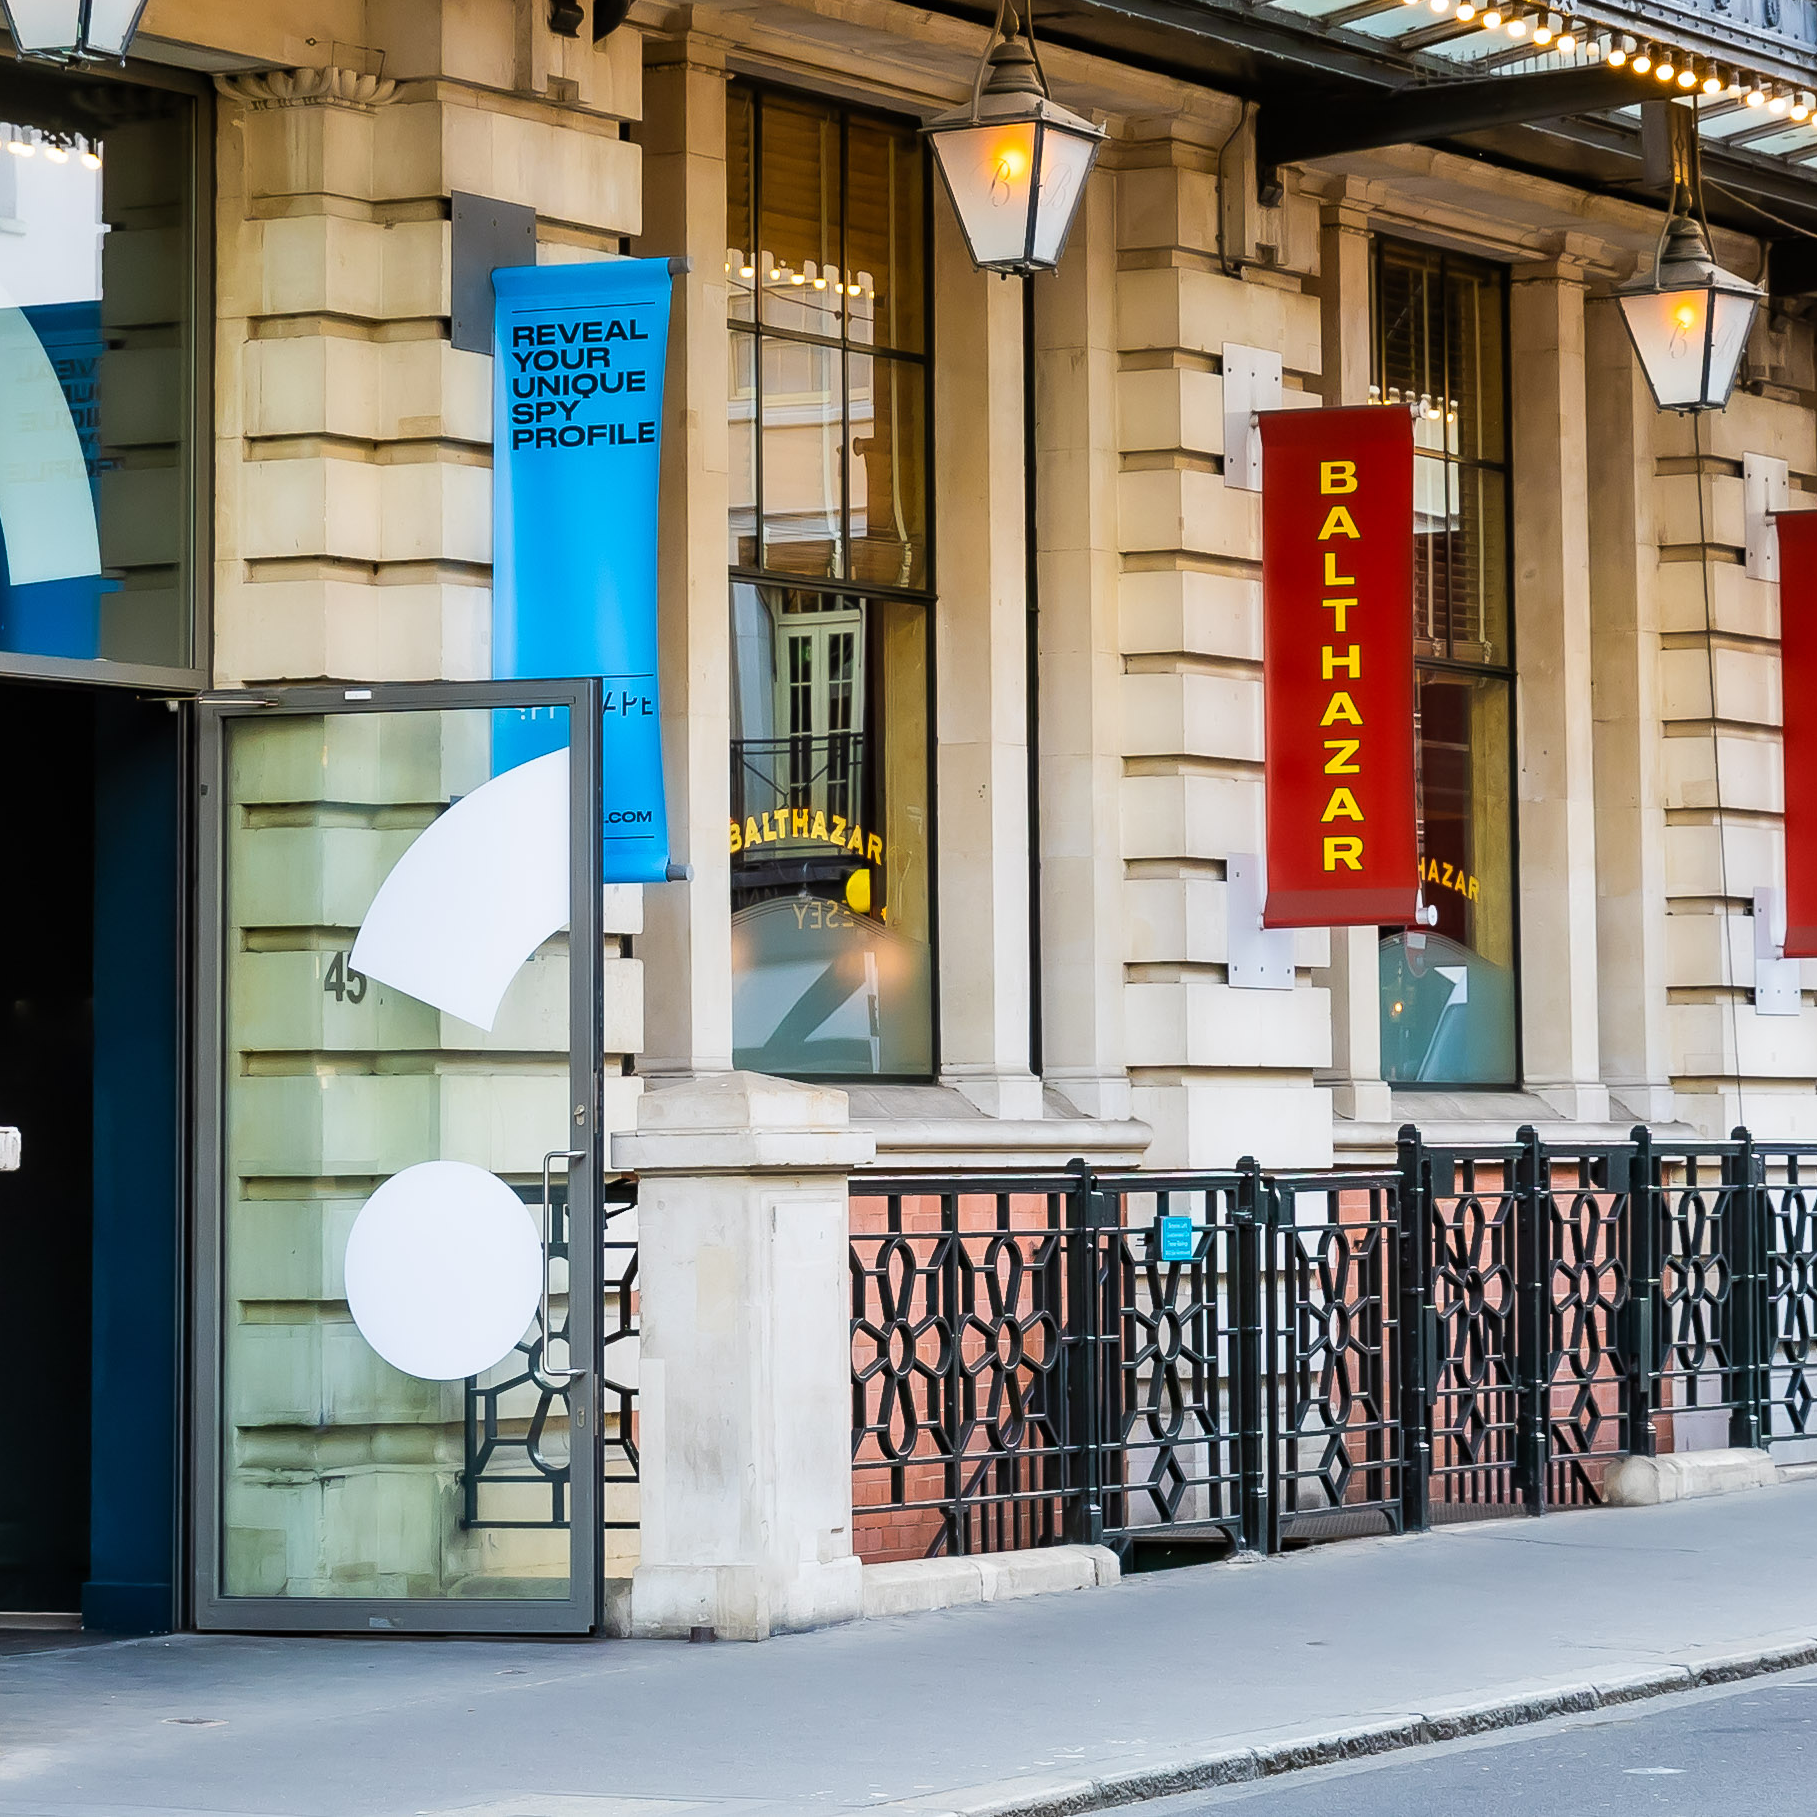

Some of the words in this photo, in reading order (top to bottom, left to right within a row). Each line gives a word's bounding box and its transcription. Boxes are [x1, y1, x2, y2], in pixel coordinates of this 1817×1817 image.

[512, 318, 648, 347] REVEAL
[512, 347, 610, 372] YOUR
[512, 370, 645, 398] UNIQUE
[512, 400, 581, 424] SPY
[512, 421, 655, 450] PROFILE
[1316, 459, 1365, 872] BALTHAZAR
[729, 808, 883, 866] BALTHAZAR
[324, 951, 367, 1004] 45
